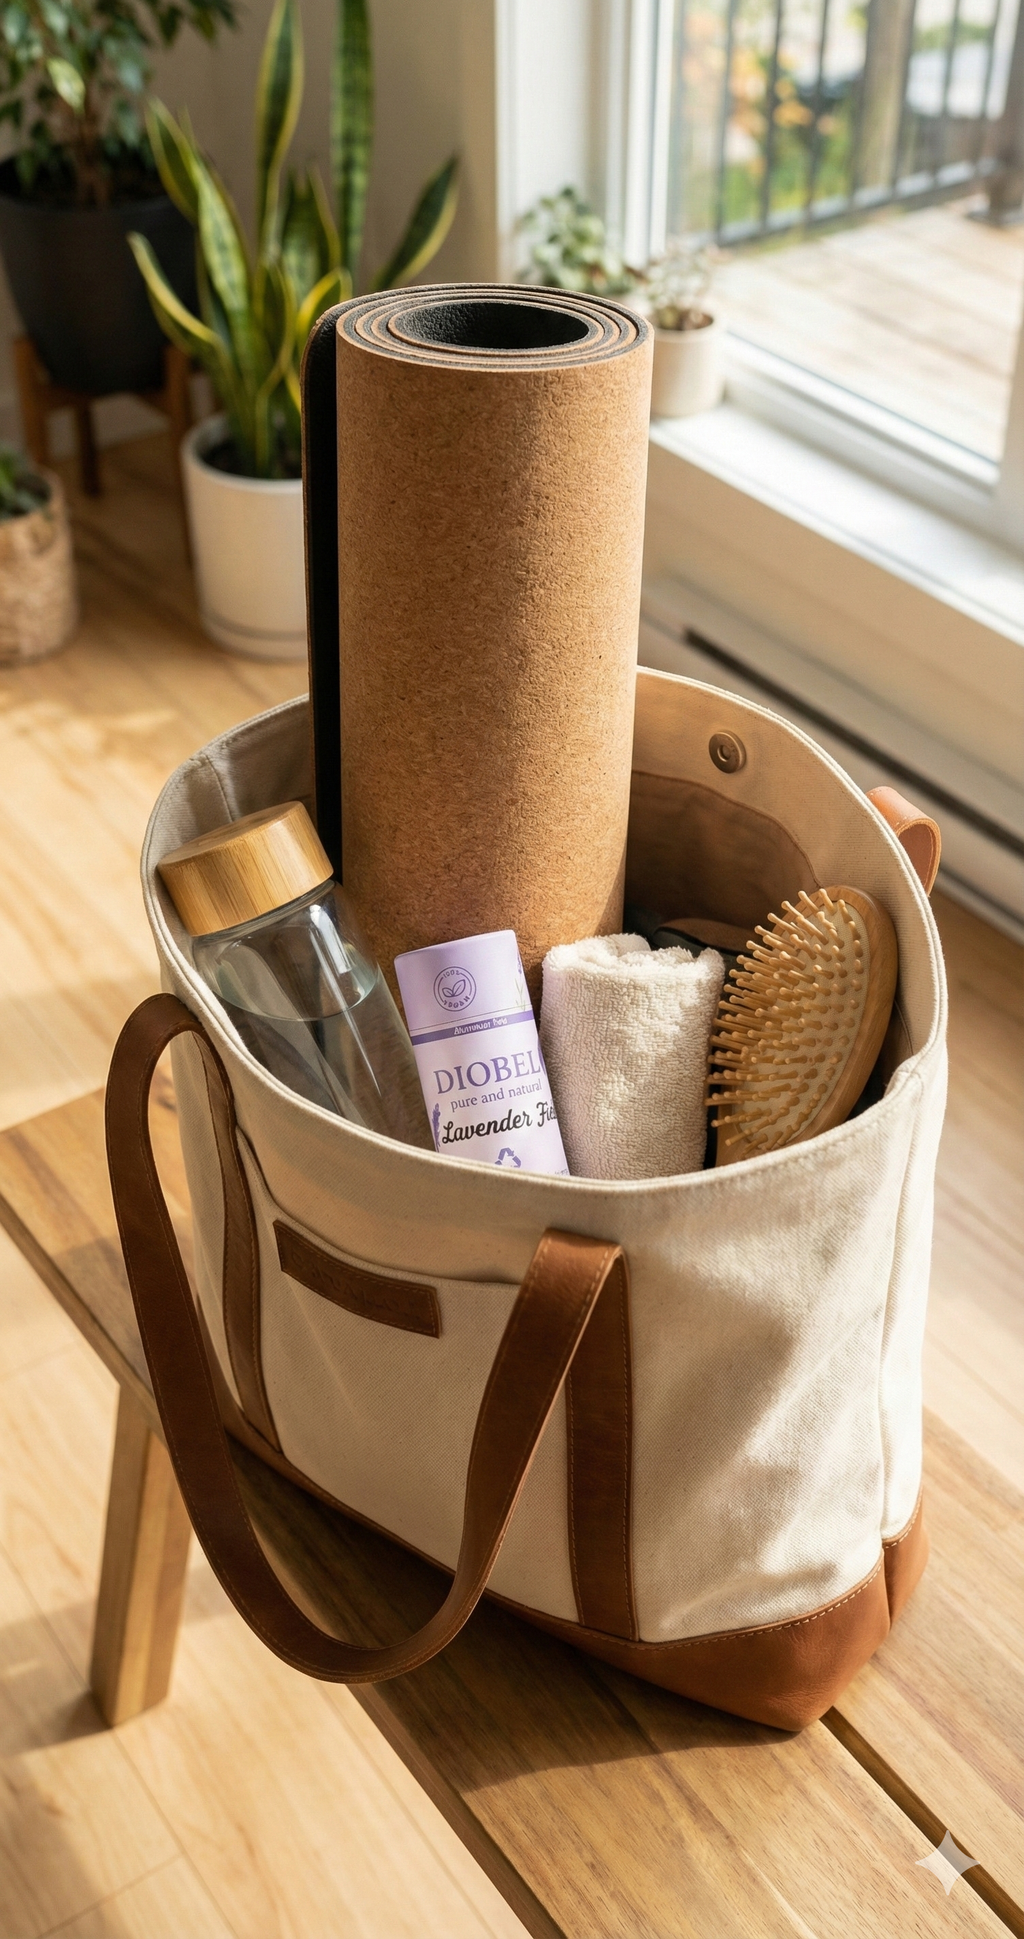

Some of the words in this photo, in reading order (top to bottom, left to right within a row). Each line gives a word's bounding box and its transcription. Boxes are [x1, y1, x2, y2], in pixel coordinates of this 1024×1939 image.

[450, 1096, 478, 1113] pure
[481, 1087, 505, 1104] and
[508, 1078, 542, 1098] natural
[442, 1108, 533, 1144] Lavender
